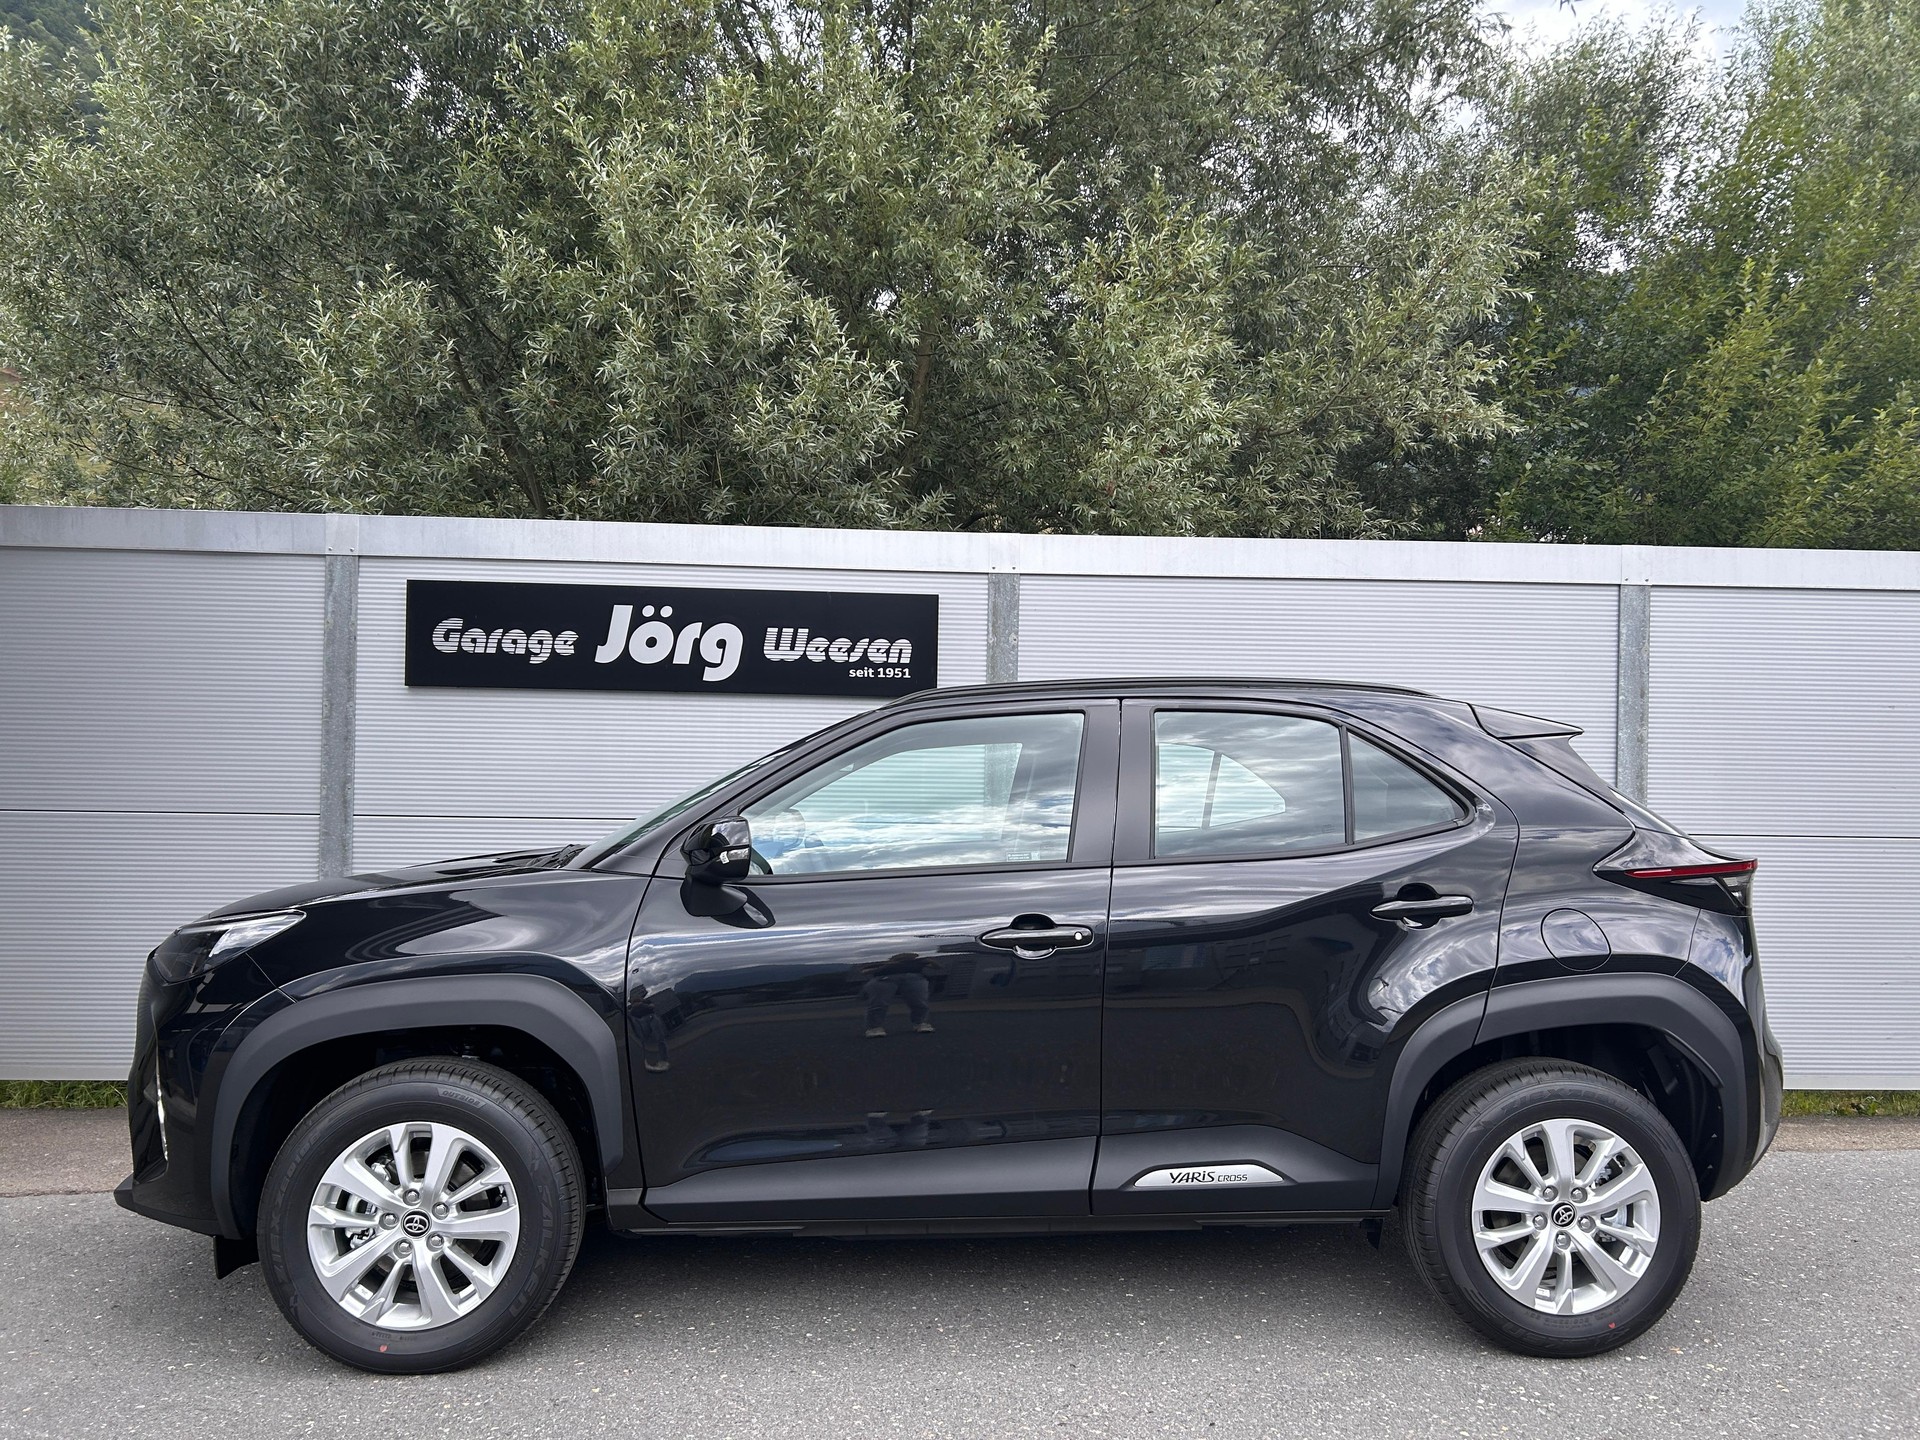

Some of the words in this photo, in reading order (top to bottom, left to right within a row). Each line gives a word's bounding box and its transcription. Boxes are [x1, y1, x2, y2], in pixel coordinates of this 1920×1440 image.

[431, 617, 579, 664] Garage
[594, 604, 744, 681] Jörg
[763, 627, 913, 664] Weesen
[849, 666, 875, 678] seit
[877, 667, 911, 678] 1951
[441, 1090, 482, 1107] OUTSIDE
[1217, 1173, 1249, 1183] CROSS
